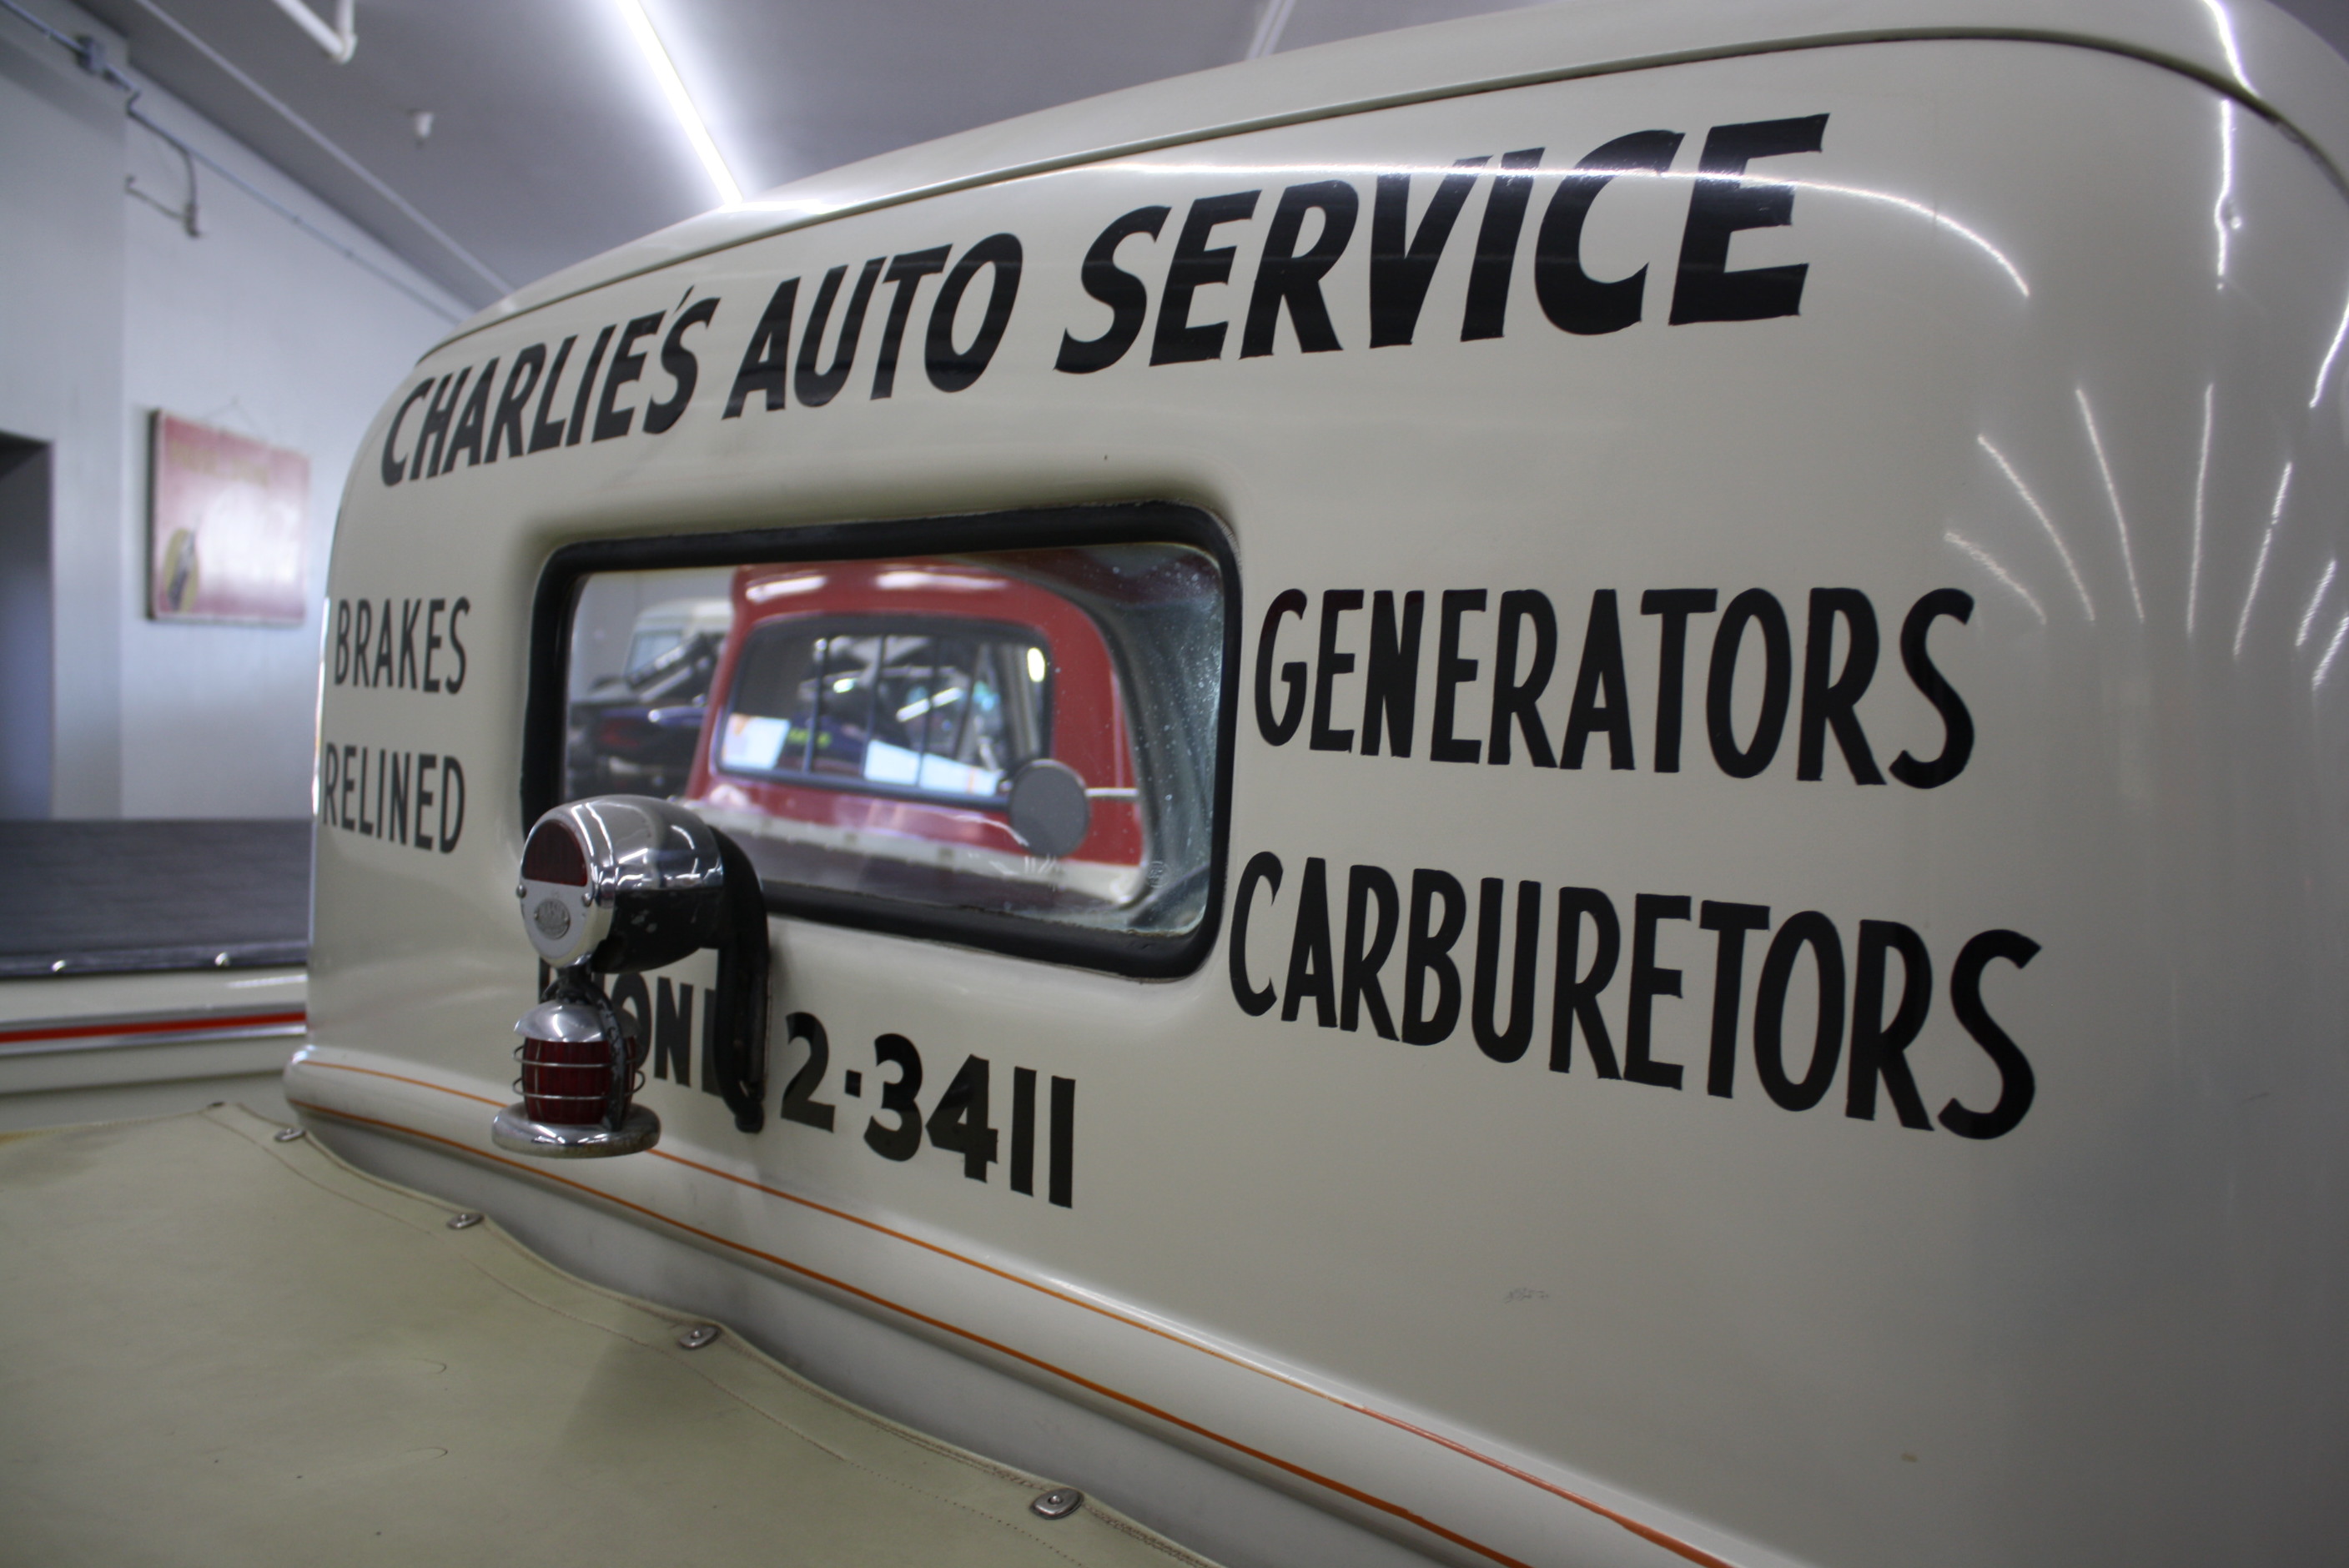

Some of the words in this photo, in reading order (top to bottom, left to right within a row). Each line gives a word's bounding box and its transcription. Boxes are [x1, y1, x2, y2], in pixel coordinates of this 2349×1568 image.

[381, 286, 721, 487] CHARLIE'S
[722, 233, 1024, 420] AUTO
[1053, 113, 1830, 374] SERVICE
[334, 597, 470, 695] BRAKES
[1254, 587, 1976, 790] GENERATORS
[323, 742, 465, 854] RELINED
[1229, 851, 2043, 1141] CARBURETORS
